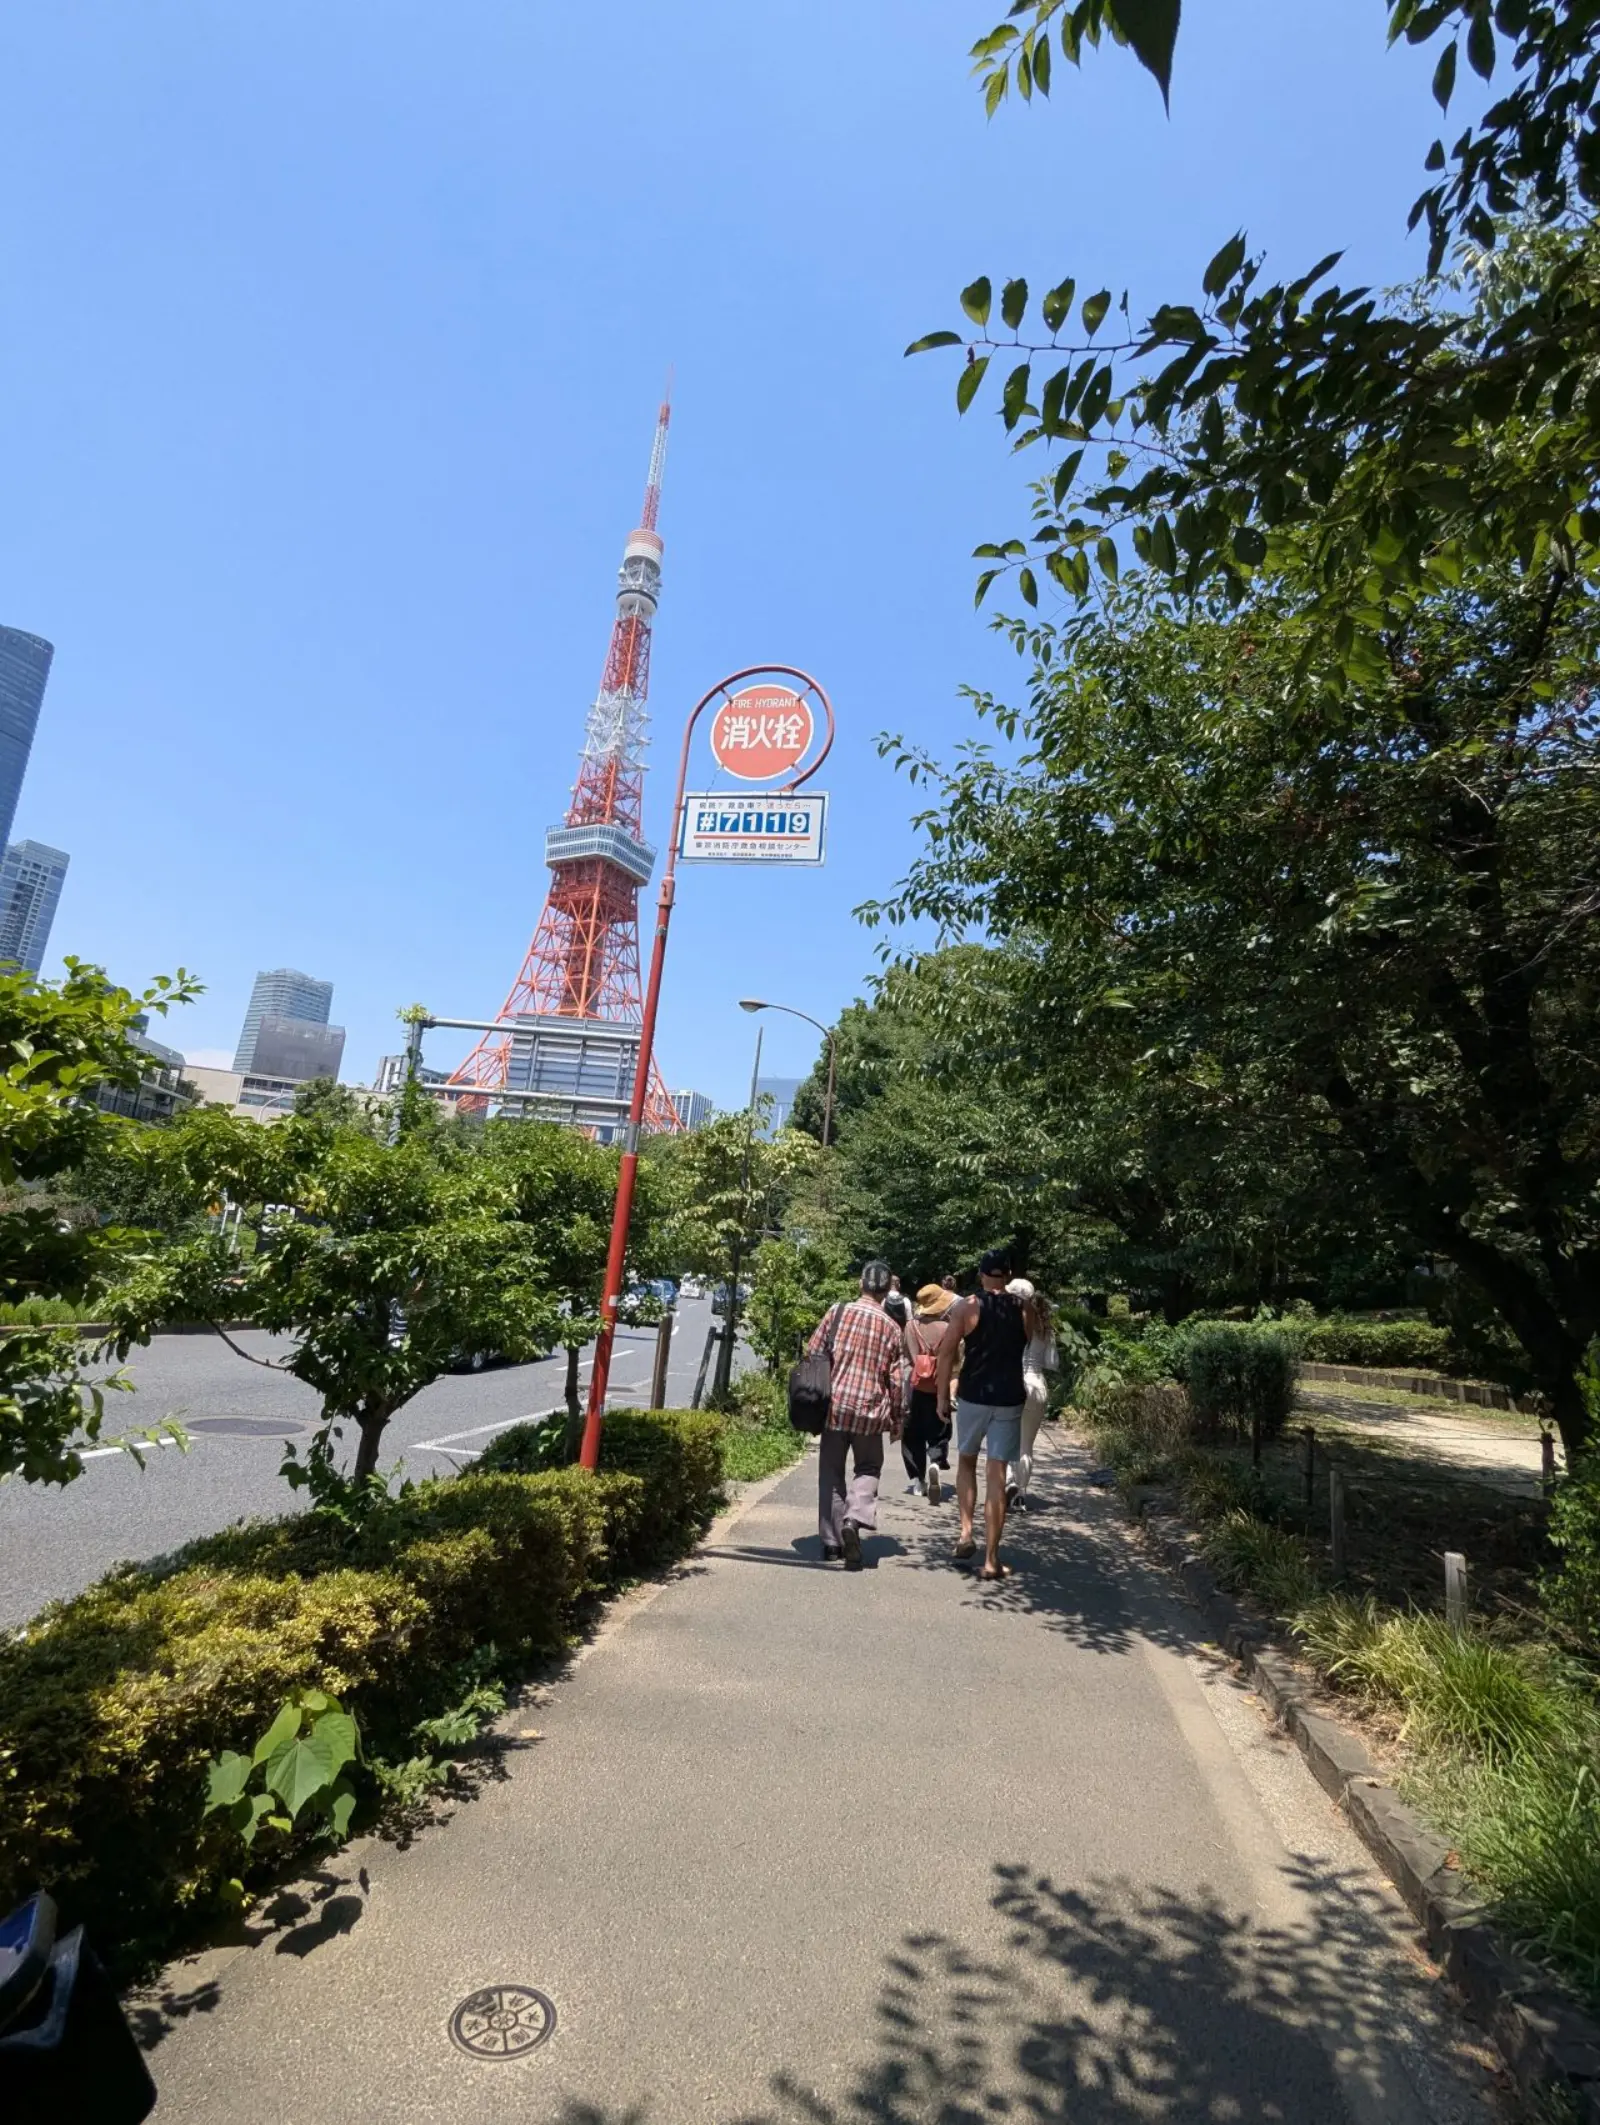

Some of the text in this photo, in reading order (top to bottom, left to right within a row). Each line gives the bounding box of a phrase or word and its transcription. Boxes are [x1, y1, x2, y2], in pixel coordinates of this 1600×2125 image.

[732, 697, 797, 709] FIRE HYDRANT
[720, 713, 804, 750] 消火栓
[699, 813, 807, 832] #7119
